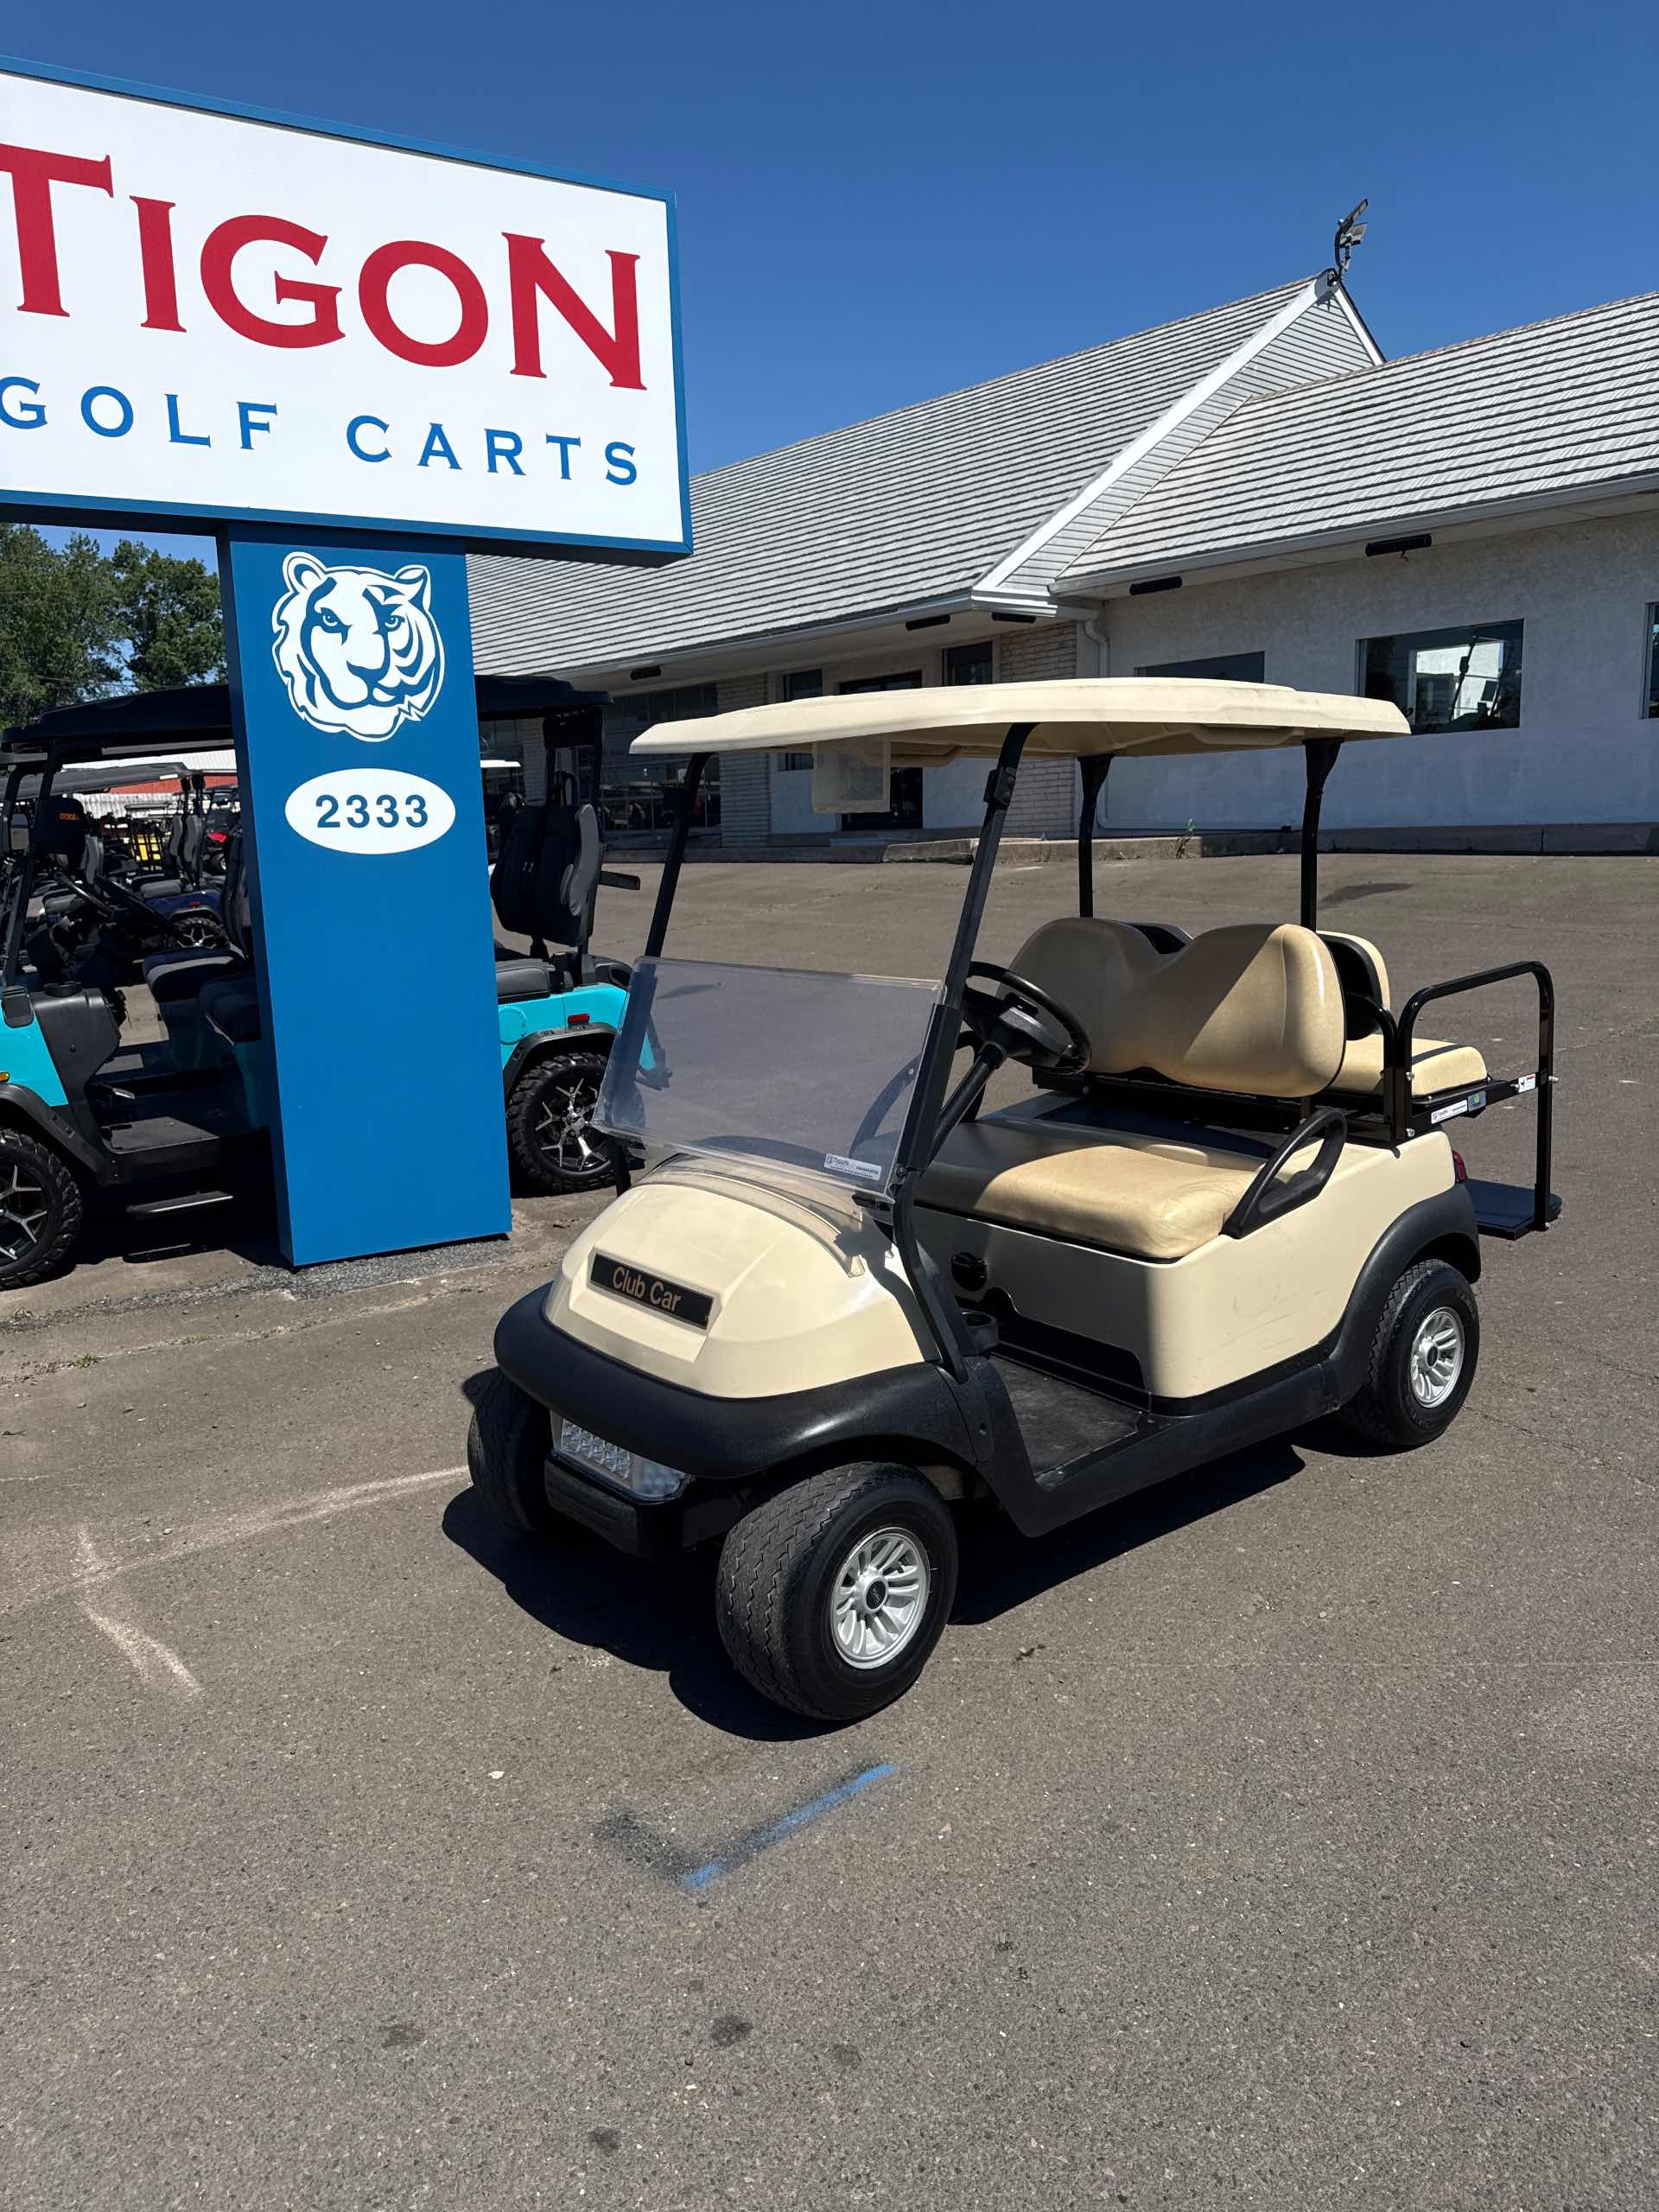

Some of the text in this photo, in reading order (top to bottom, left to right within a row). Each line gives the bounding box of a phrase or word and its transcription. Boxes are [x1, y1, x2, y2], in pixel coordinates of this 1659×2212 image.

[0, 143, 647, 391] TIGON
[0, 376, 638, 486] GOLF CARTS
[315, 794, 429, 828] 2333
[613, 1267, 683, 1312] Club Car
